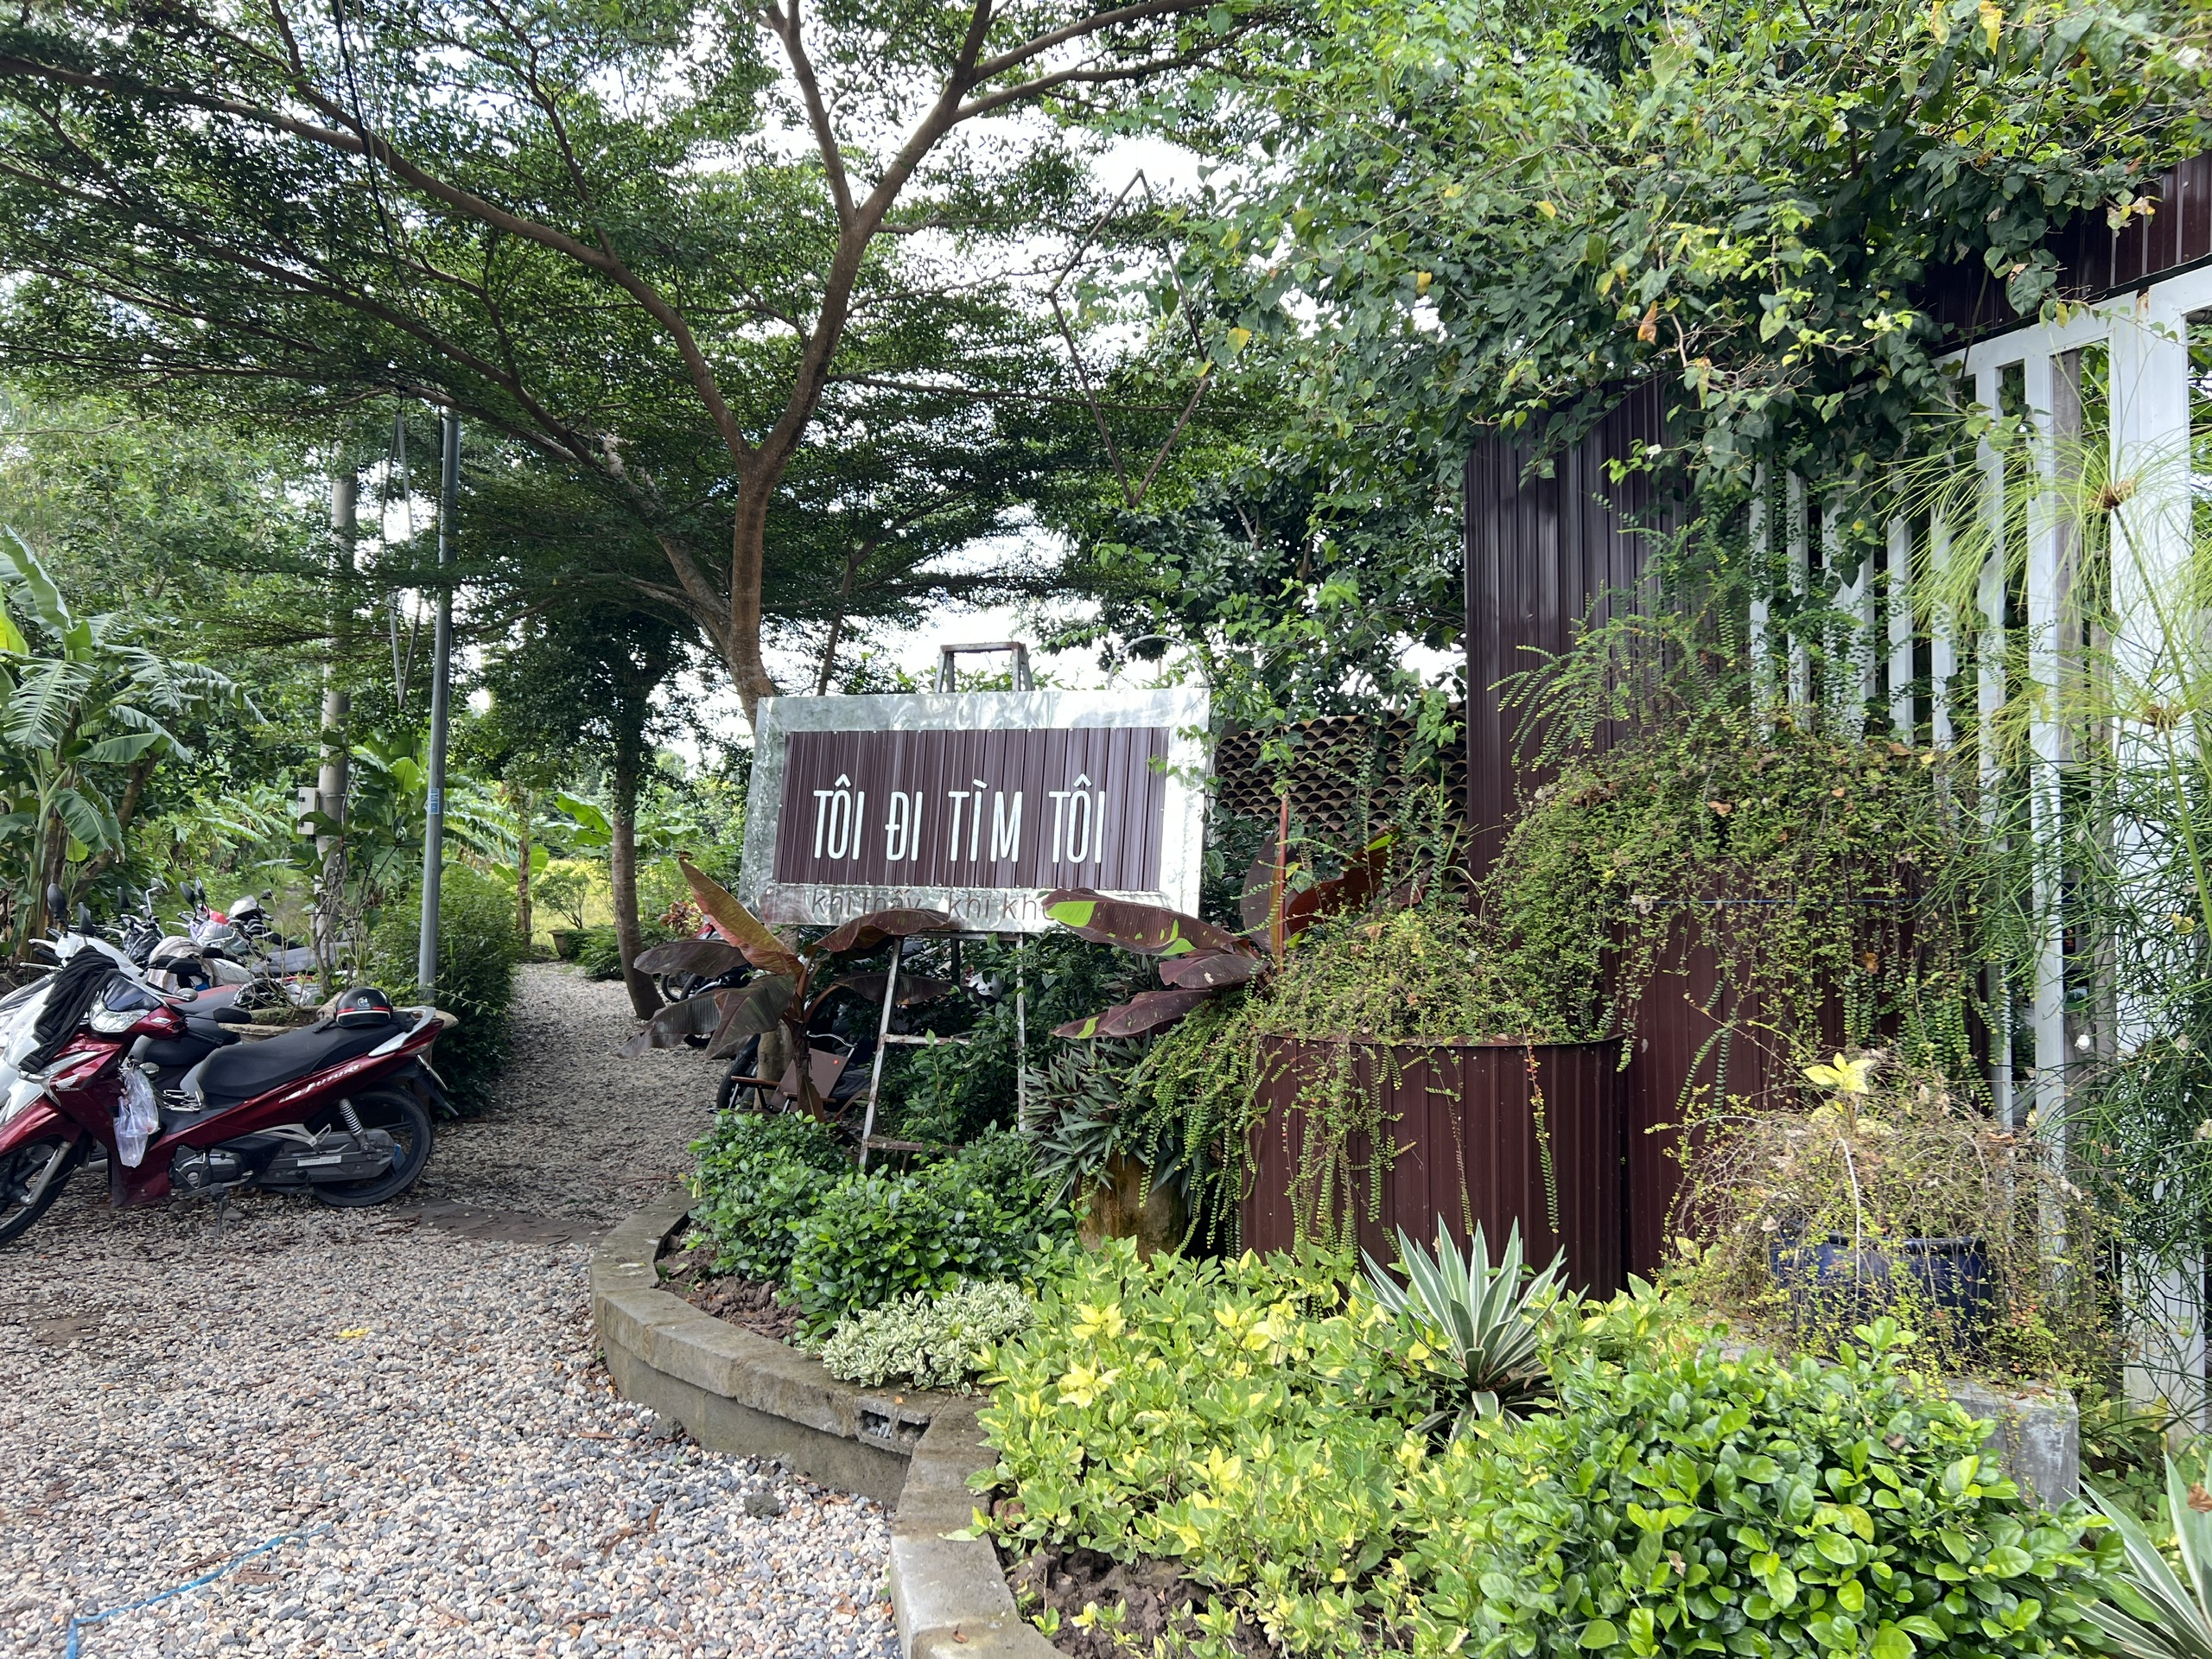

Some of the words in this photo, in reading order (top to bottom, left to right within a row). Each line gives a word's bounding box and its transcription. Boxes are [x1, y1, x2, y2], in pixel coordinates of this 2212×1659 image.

[813, 773, 865, 860] TÔI
[885, 791, 923, 861] ĐI
[948, 779, 1023, 862] TÌM
[1048, 772, 1106, 863] TÔI
[811, 888, 852, 916] khi
[948, 889, 990, 919] khi
